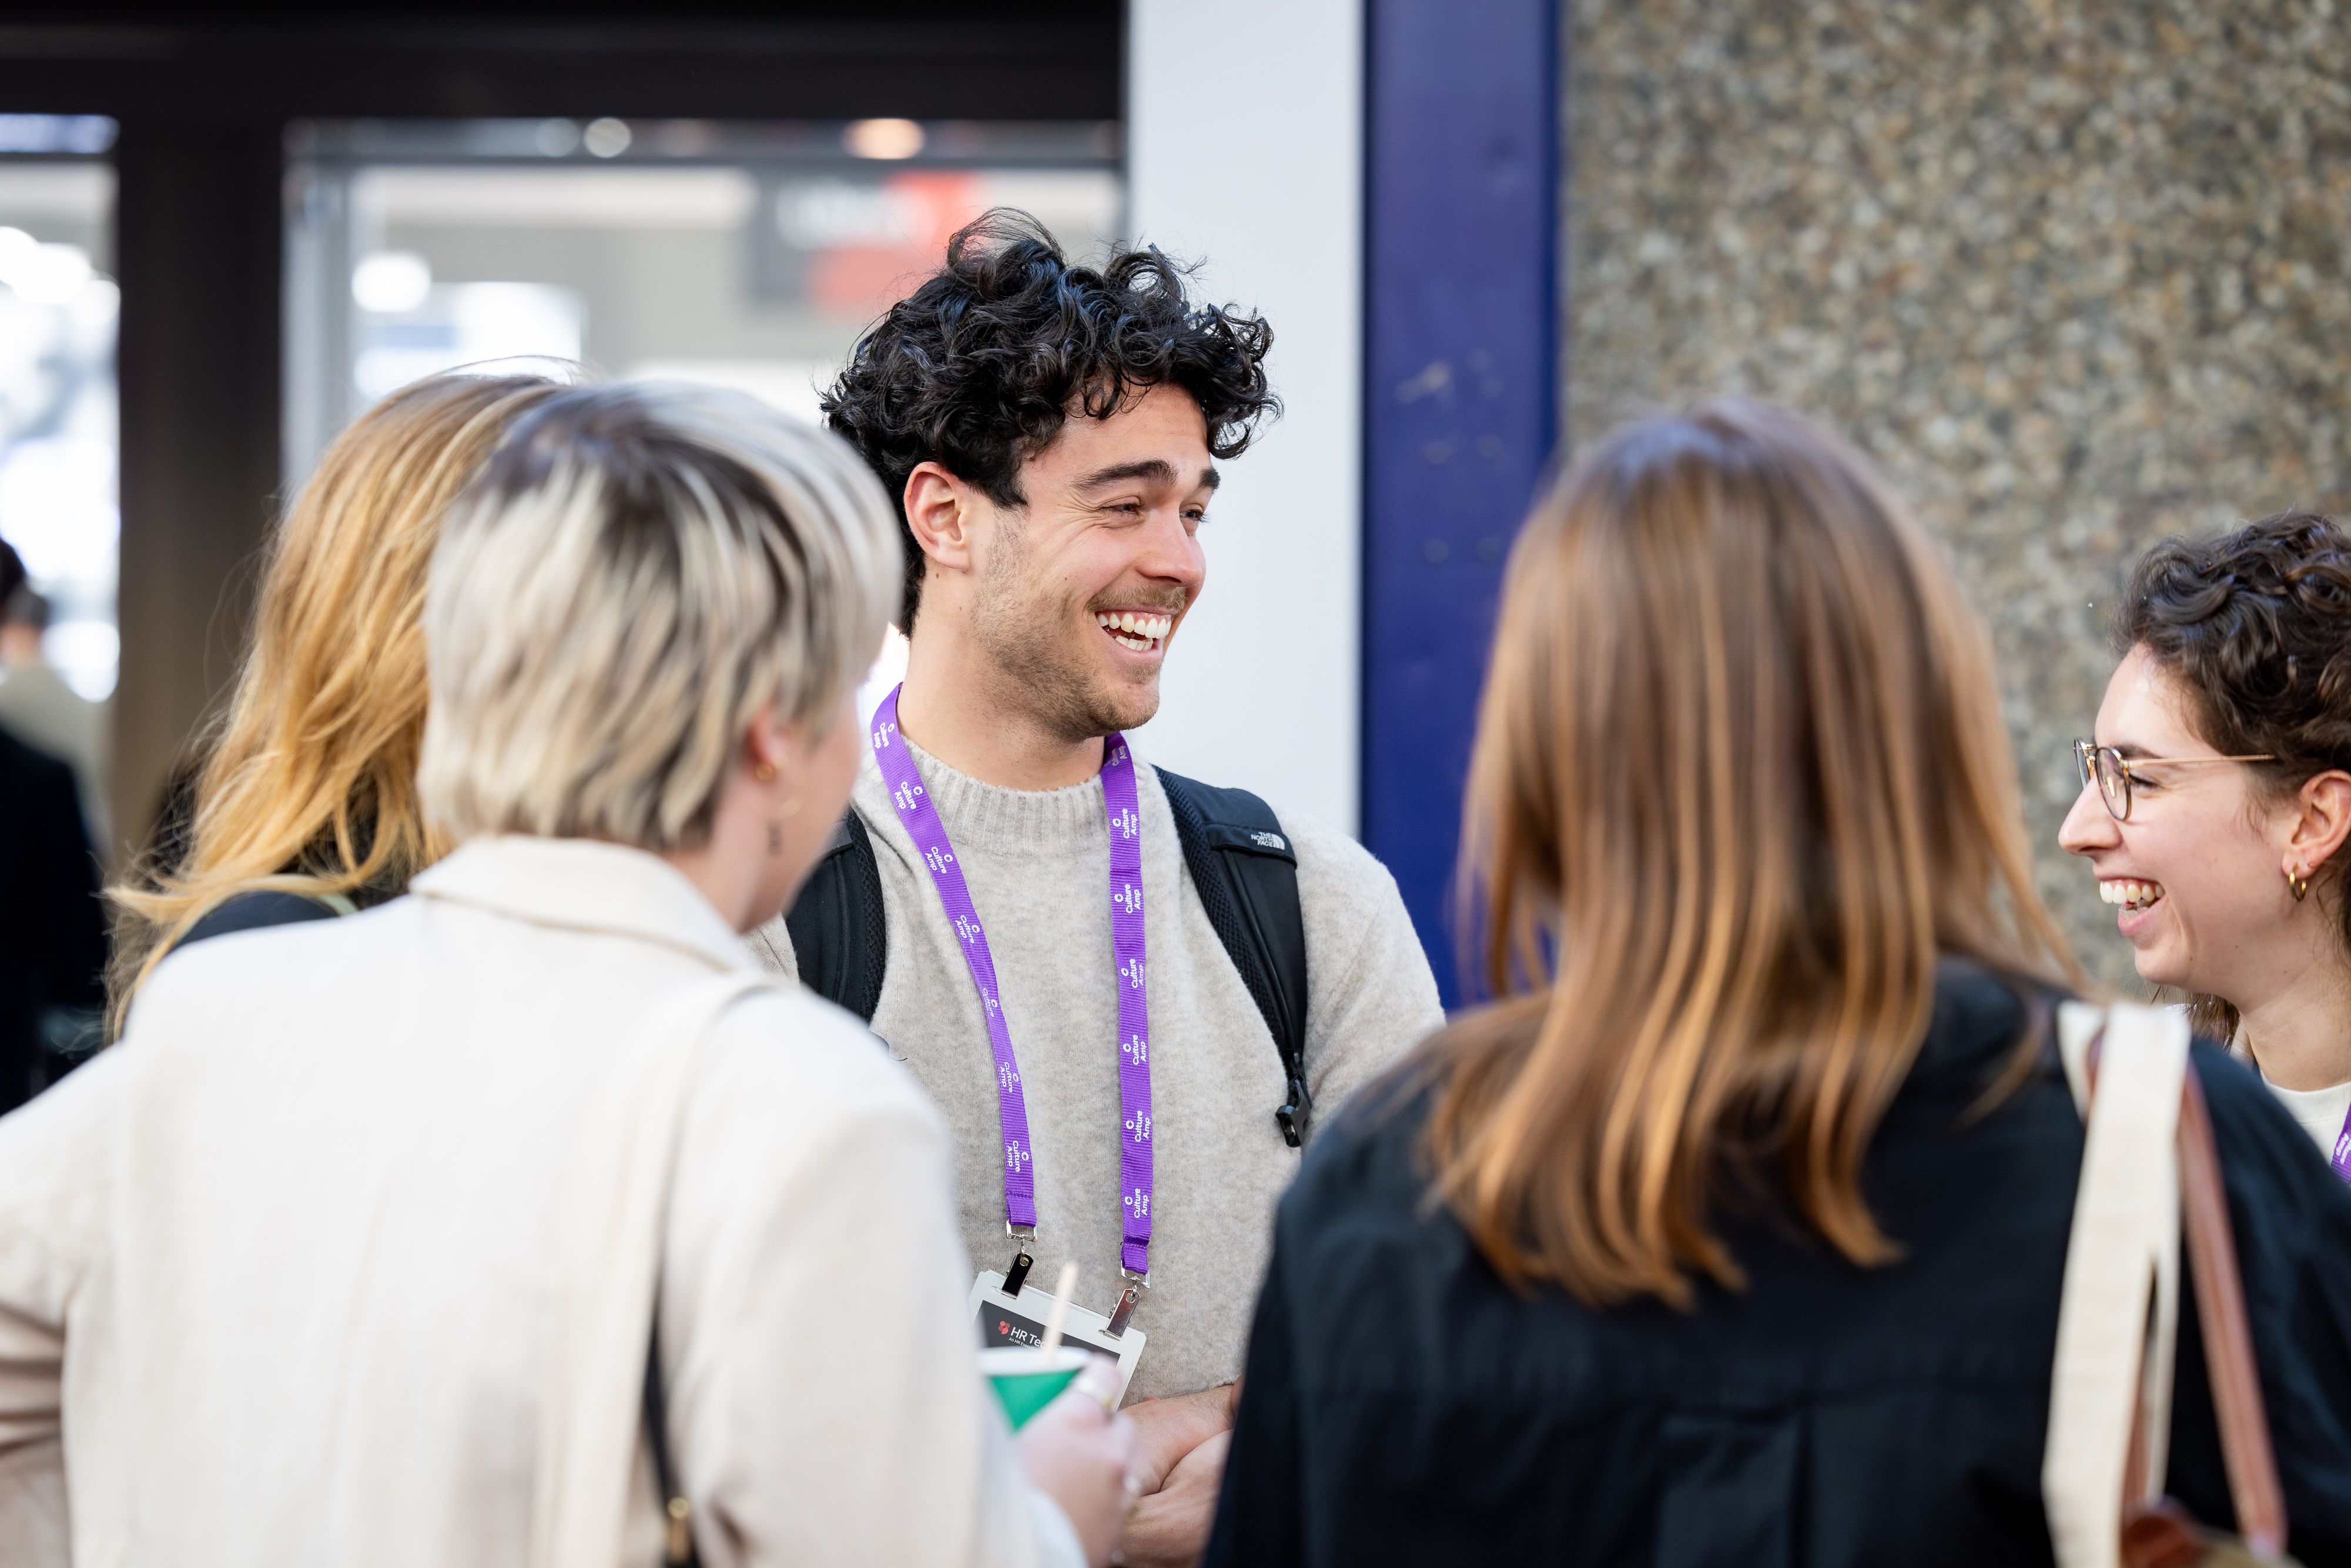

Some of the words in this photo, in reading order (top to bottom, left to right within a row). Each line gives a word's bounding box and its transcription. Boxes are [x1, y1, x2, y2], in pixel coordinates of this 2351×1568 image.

[1118, 745, 1127, 759] Amp
[894, 791, 906, 809] Amp
[900, 781, 917, 810] Culture
[1121, 808, 1131, 839] Culture
[1130, 813, 1138, 836] Amp
[925, 853, 938, 871] Amp
[931, 846, 947, 874] Culture
[1124, 883, 1133, 914] Culture
[1133, 889, 1142, 910] Amp
[955, 920, 967, 939] Amp
[960, 914, 974, 944] Culture
[1129, 958, 1138, 989] Culture
[1004, 1061, 1013, 1093] Culture
[1134, 1110, 1143, 1143] Culture
[1143, 1117, 1151, 1140] Amp
[1012, 1140, 1021, 1172] Culture
[1133, 1188, 1141, 1219] Culture
[1141, 1194, 1150, 1216] Amp
[1010, 1326, 1028, 1342] HR
[1029, 1333, 1047, 1349] Tec
